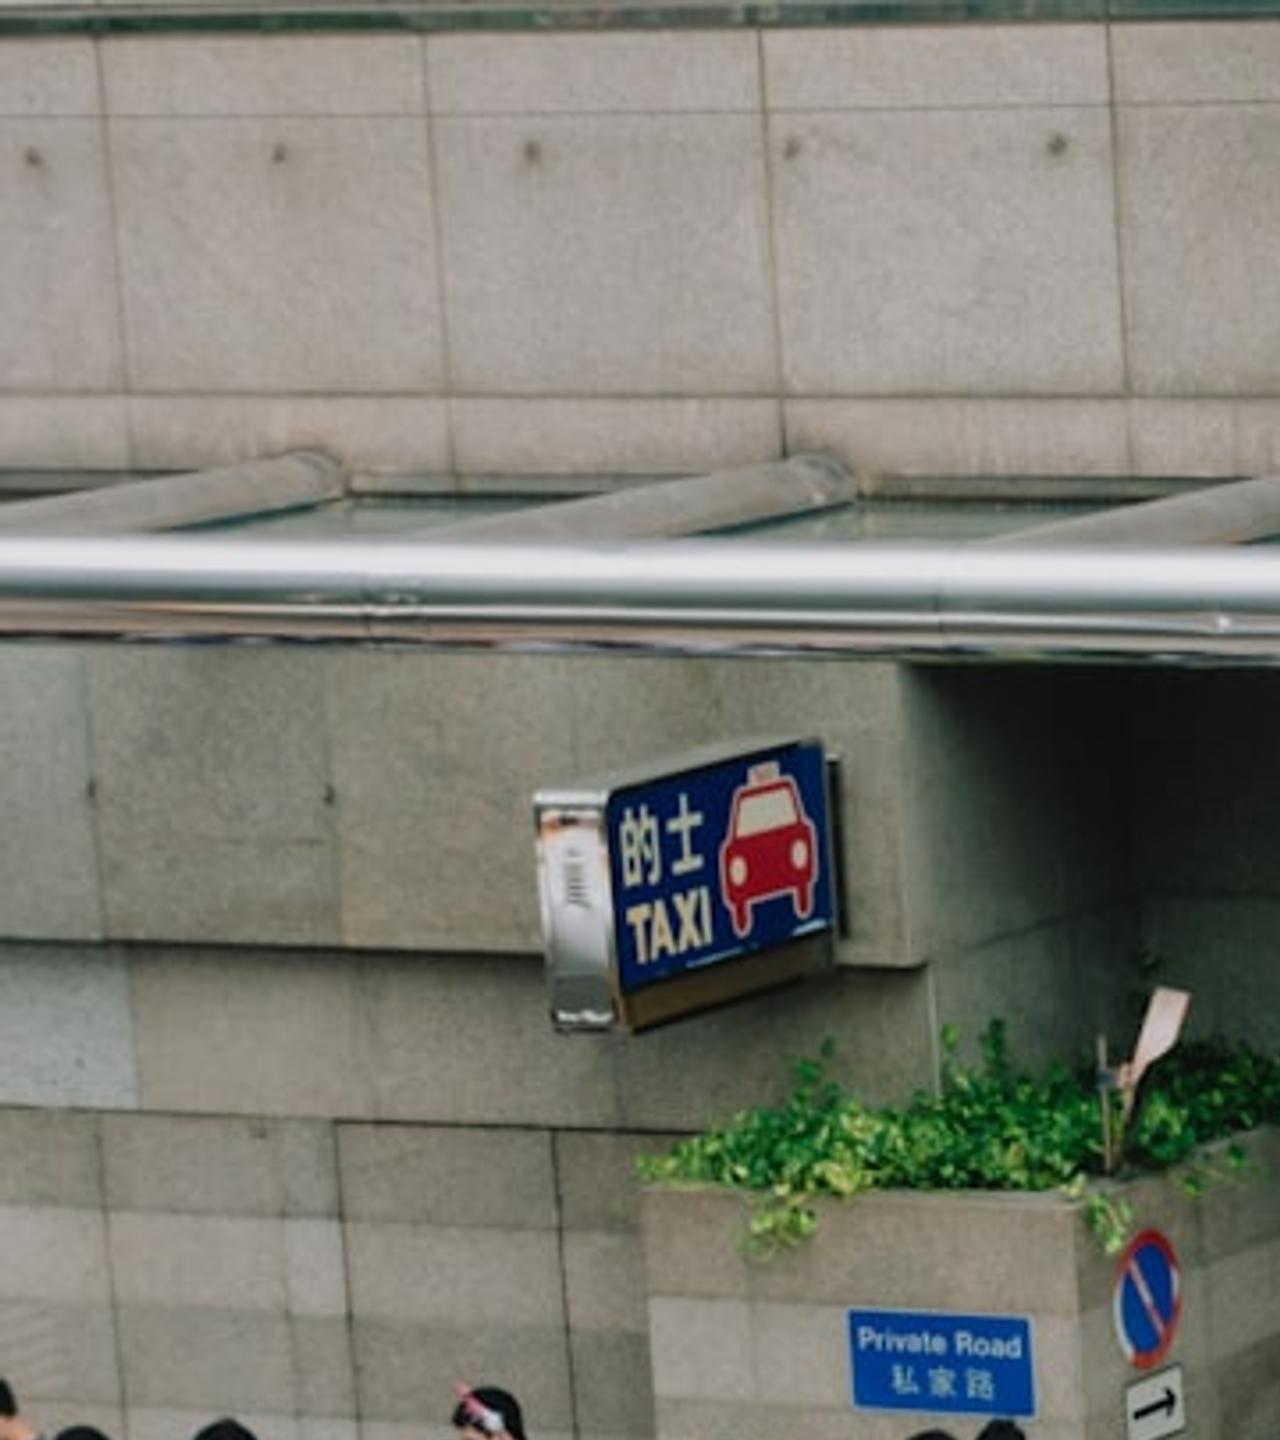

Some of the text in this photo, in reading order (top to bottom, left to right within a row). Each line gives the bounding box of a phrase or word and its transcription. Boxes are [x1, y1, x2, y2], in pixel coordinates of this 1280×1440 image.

[620, 793, 704, 888] 的士
[626, 885, 713, 965] TAXI
[857, 1325, 1023, 1360] Private Road
[891, 1363, 995, 1400] 私家路
